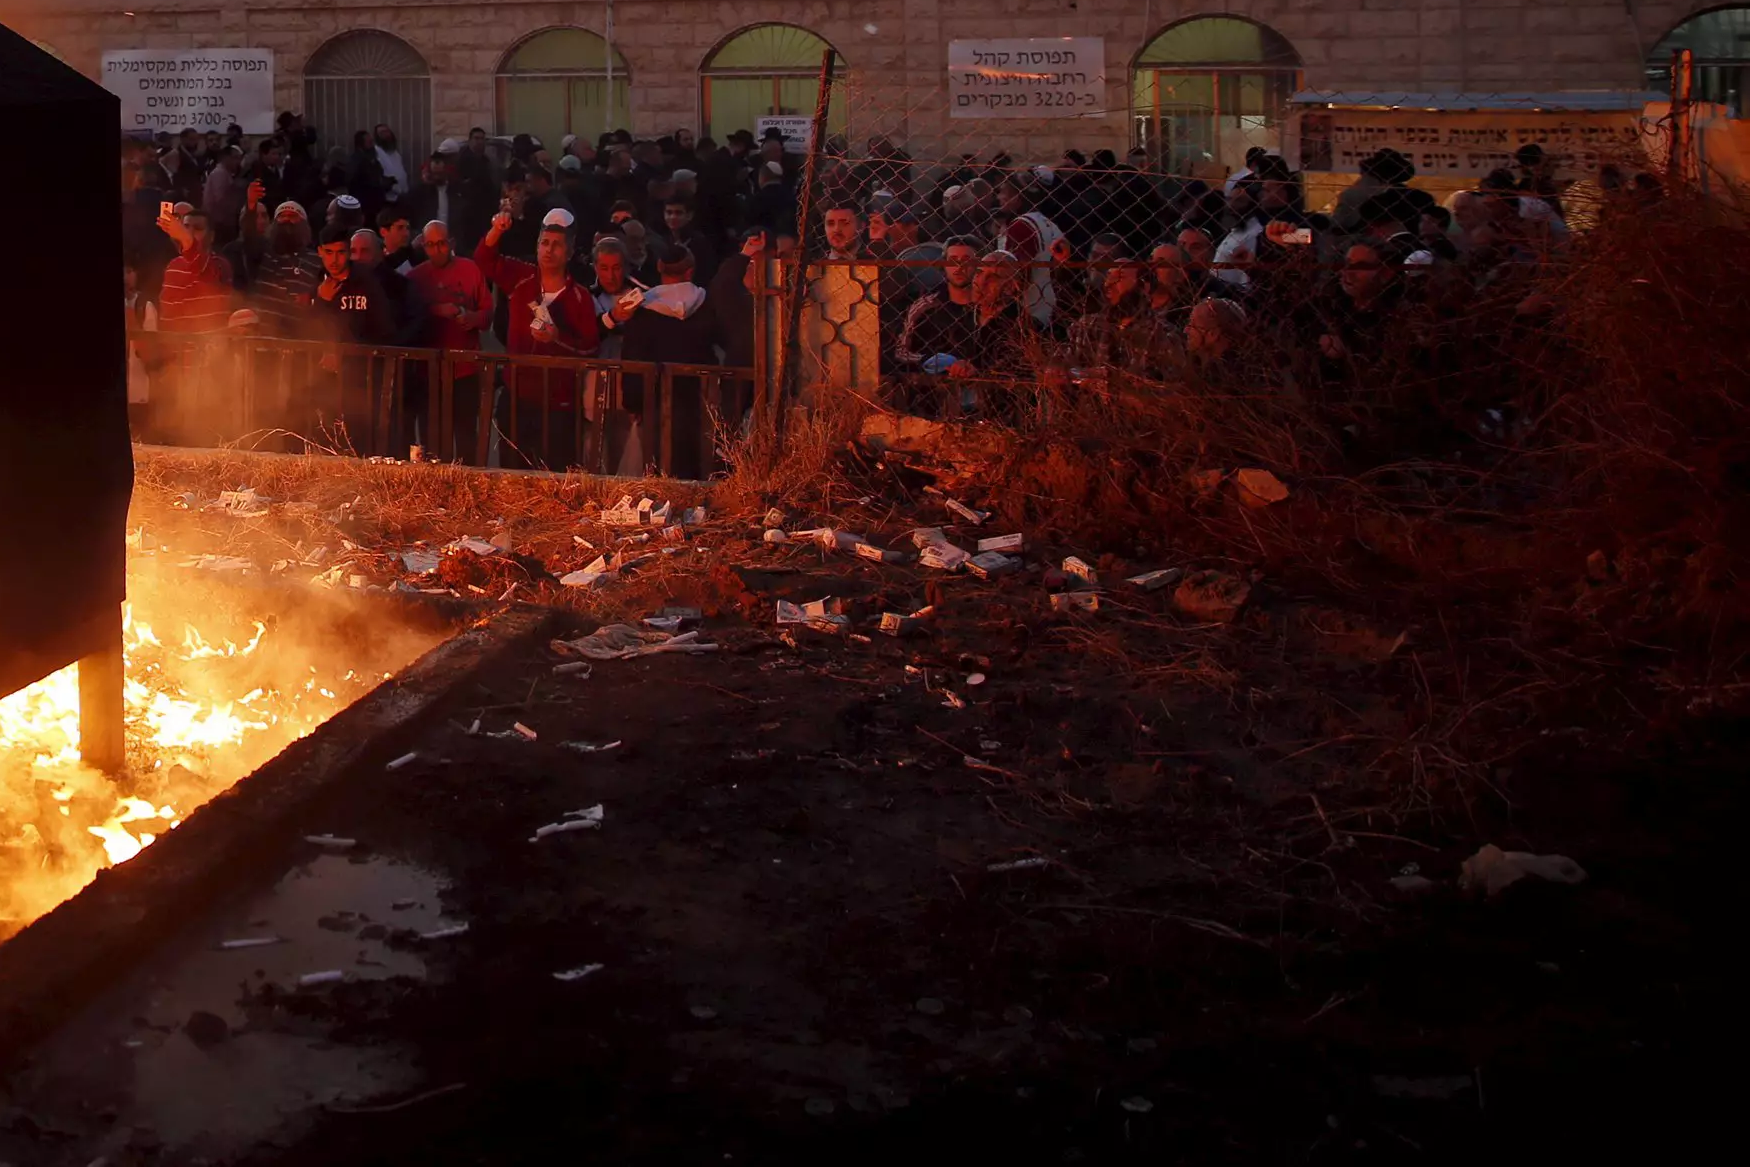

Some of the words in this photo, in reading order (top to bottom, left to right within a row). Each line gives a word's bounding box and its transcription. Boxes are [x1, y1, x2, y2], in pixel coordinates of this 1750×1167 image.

[972, 49, 1010, 67] קהל
[1016, 50, 1076, 64] תפוסת
[107, 58, 177, 73] מקסימלית
[180, 58, 218, 72] כללית
[222, 58, 268, 72] תפוסה
[139, 77, 204, 90] המתחמים
[207, 76, 232, 90] בכל
[146, 96, 184, 108] ונשים
[187, 96, 225, 108] גברים
[956, 92, 1027, 109] מבקרים
[1034, 91, 1096, 106] כ-3220
[134, 113, 187, 128] מבקרים
[1334, 126, 1388, 143] התורה
[1395, 127, 1440, 143] בספר
[340, 295, 367, 310] STER
